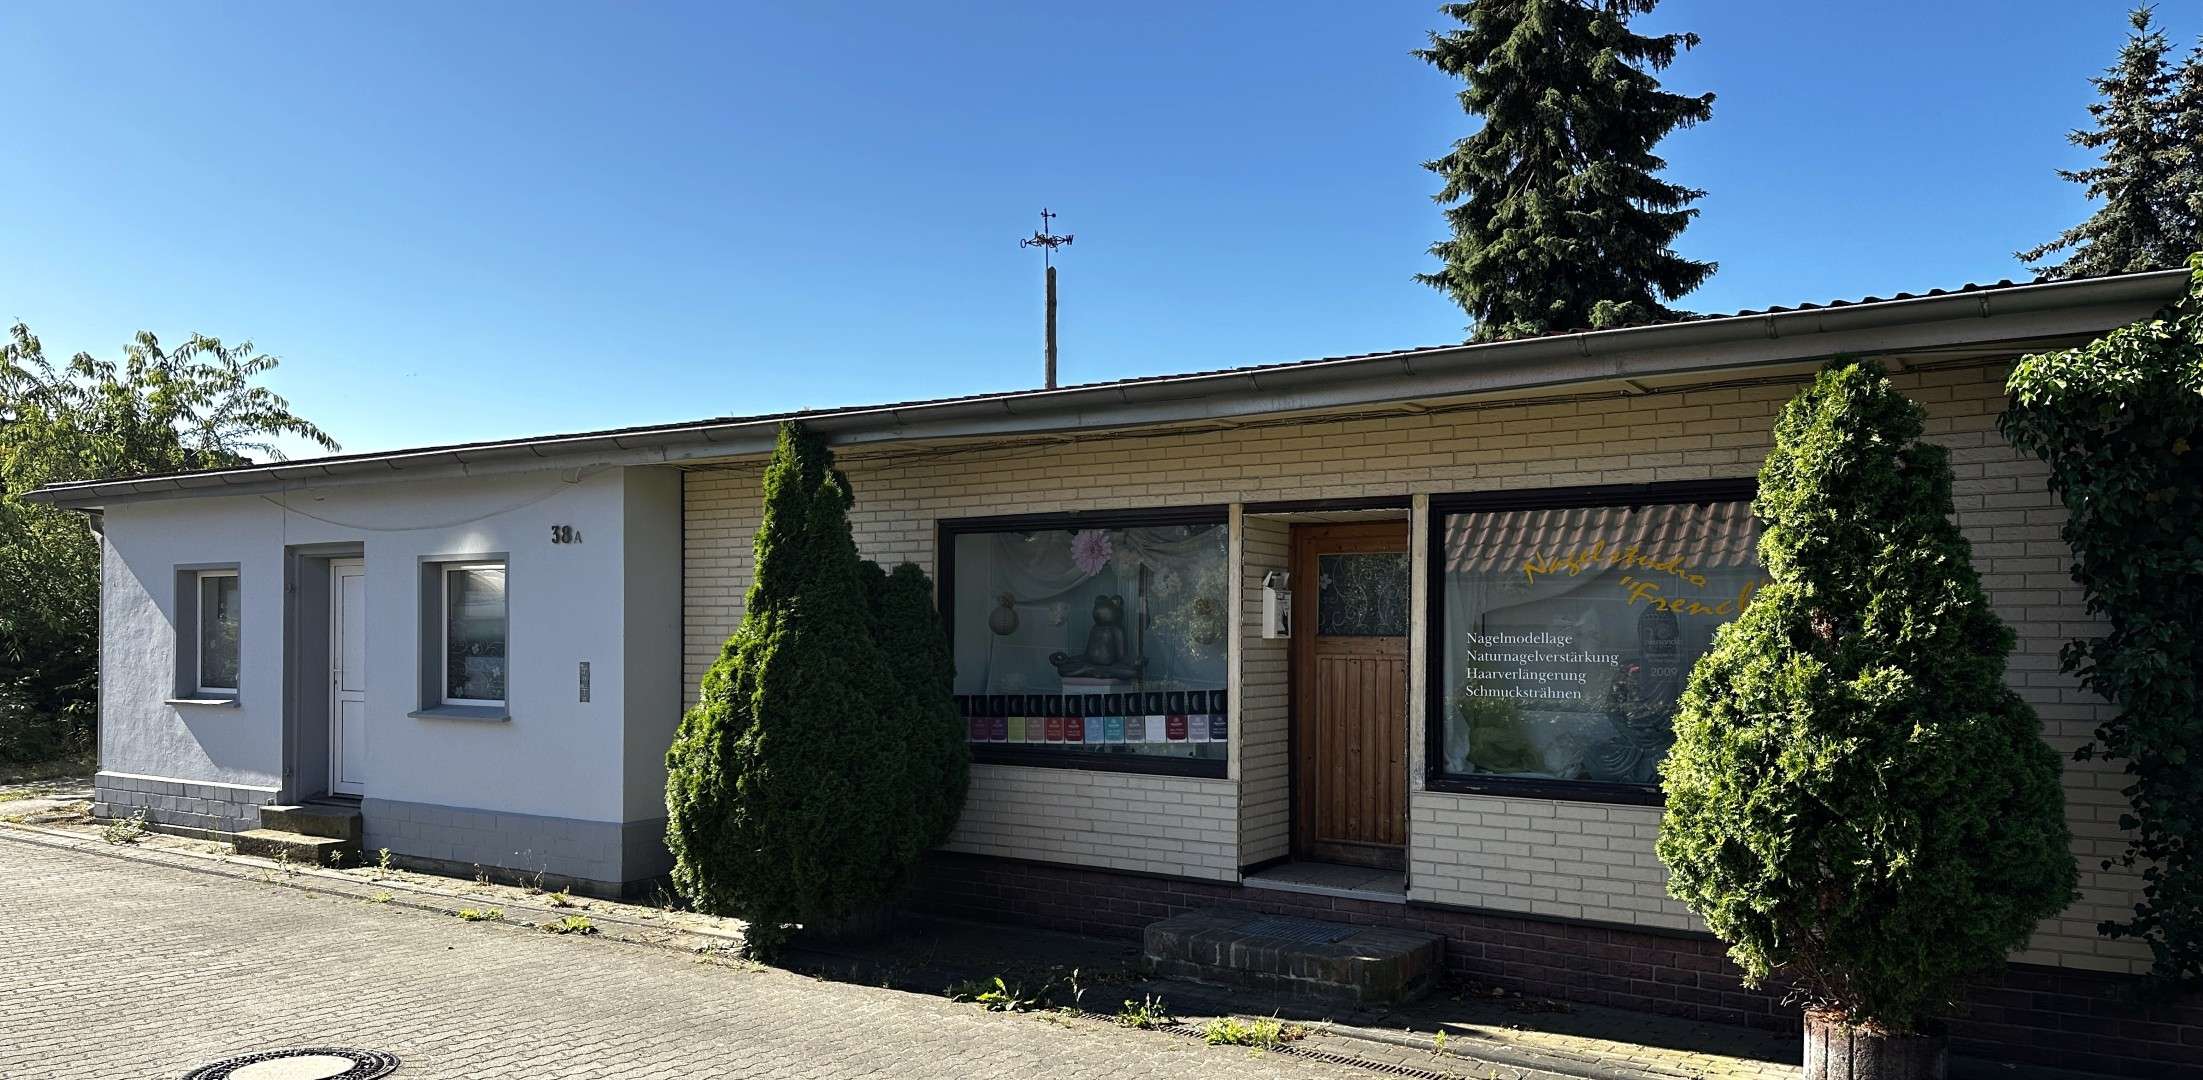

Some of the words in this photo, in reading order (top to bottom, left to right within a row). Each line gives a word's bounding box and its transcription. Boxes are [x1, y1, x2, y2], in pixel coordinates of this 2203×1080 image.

[1523, 539, 1706, 588] Nagelstudio
[1467, 632, 1573, 647] Nagelmodellage
[1466, 650, 1620, 666] Naturnagelverstärkung
[1466, 668, 1587, 684] Haarverlängerung
[1465, 685, 1582, 700] Schmucksträhnen
